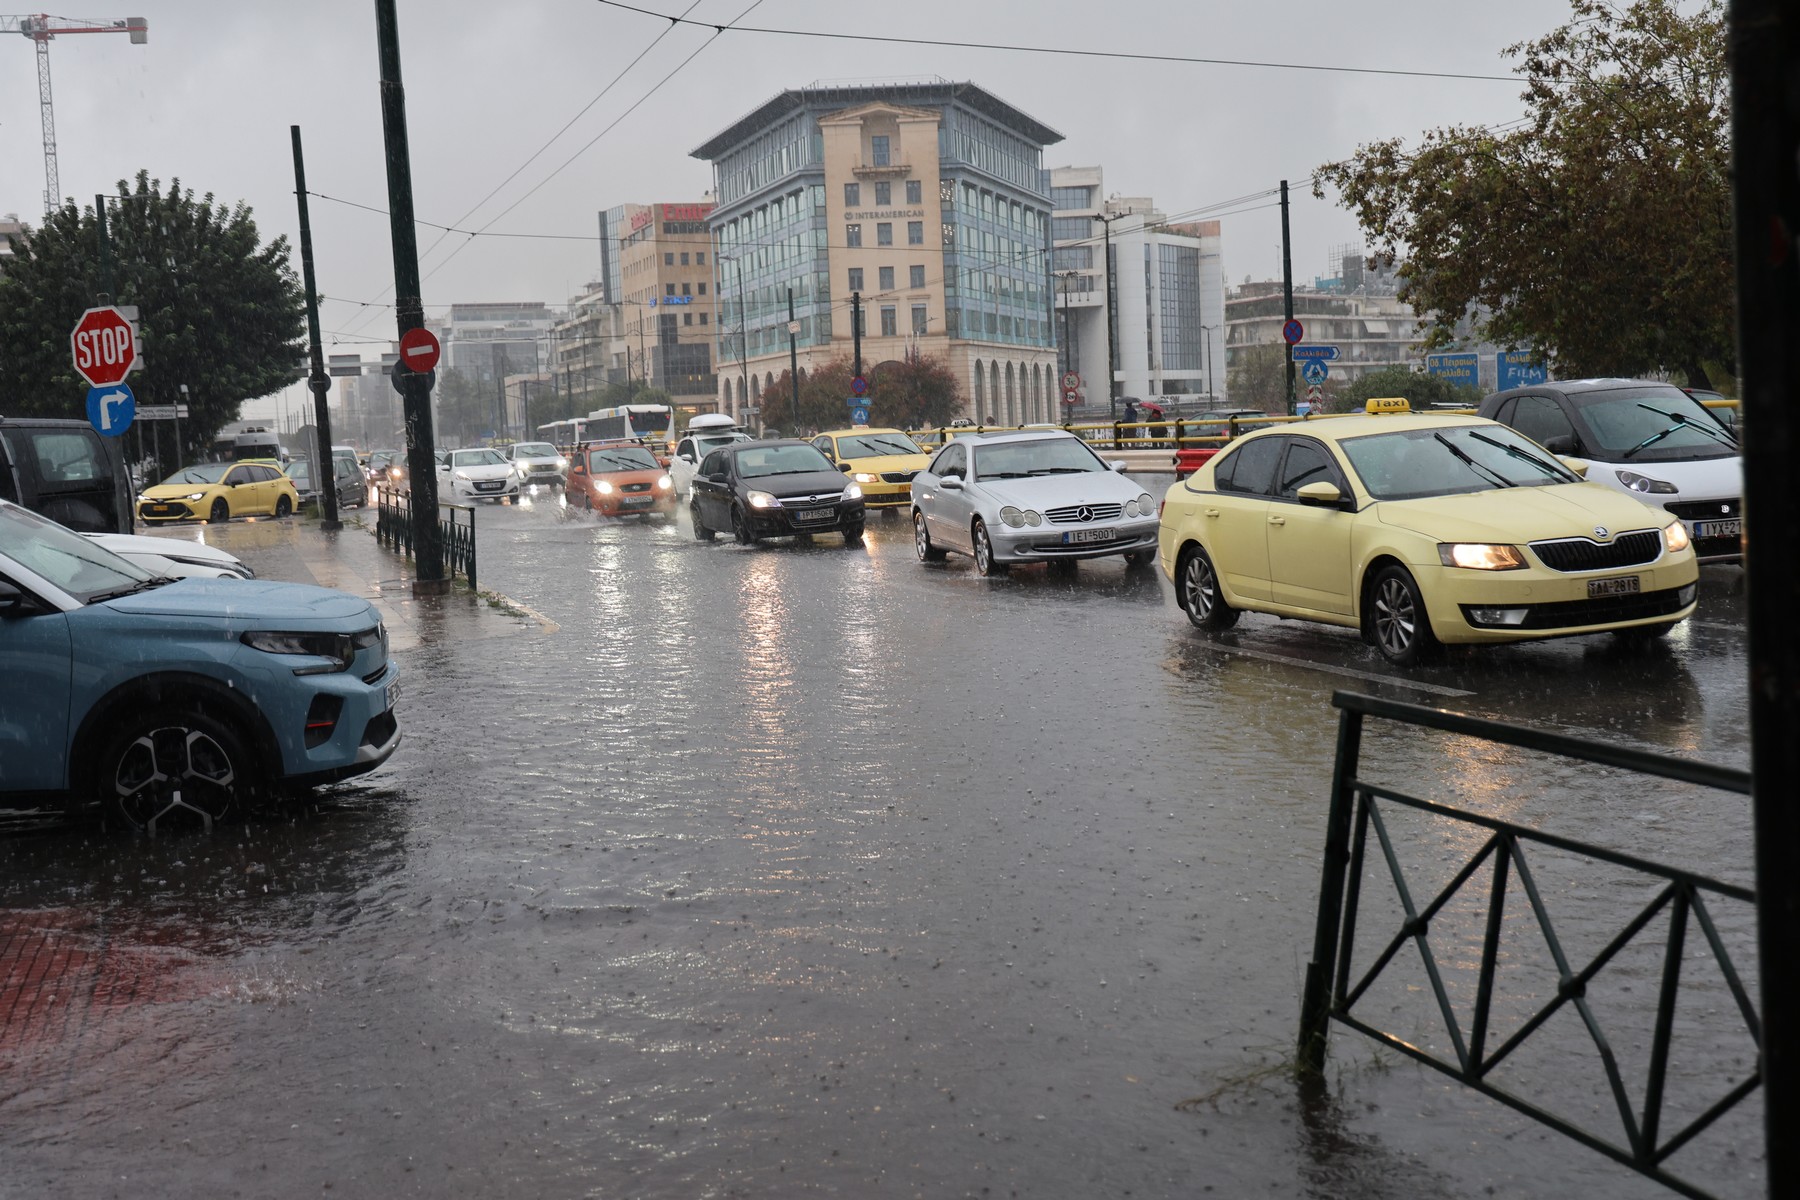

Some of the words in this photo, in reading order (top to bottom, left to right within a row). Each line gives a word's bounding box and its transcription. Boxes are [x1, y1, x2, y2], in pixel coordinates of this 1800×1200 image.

[662, 204, 715, 221] Emir
[855, 210, 925, 220] INTERAMERICAN
[77, 325, 129, 368] STOP
[1442, 356, 1477, 367] Πειραιώς
[1505, 354, 1531, 363] Καλλιθ
[1437, 368, 1471, 377] Καλλιθέα
[1374, 399, 1405, 408] Taxi
